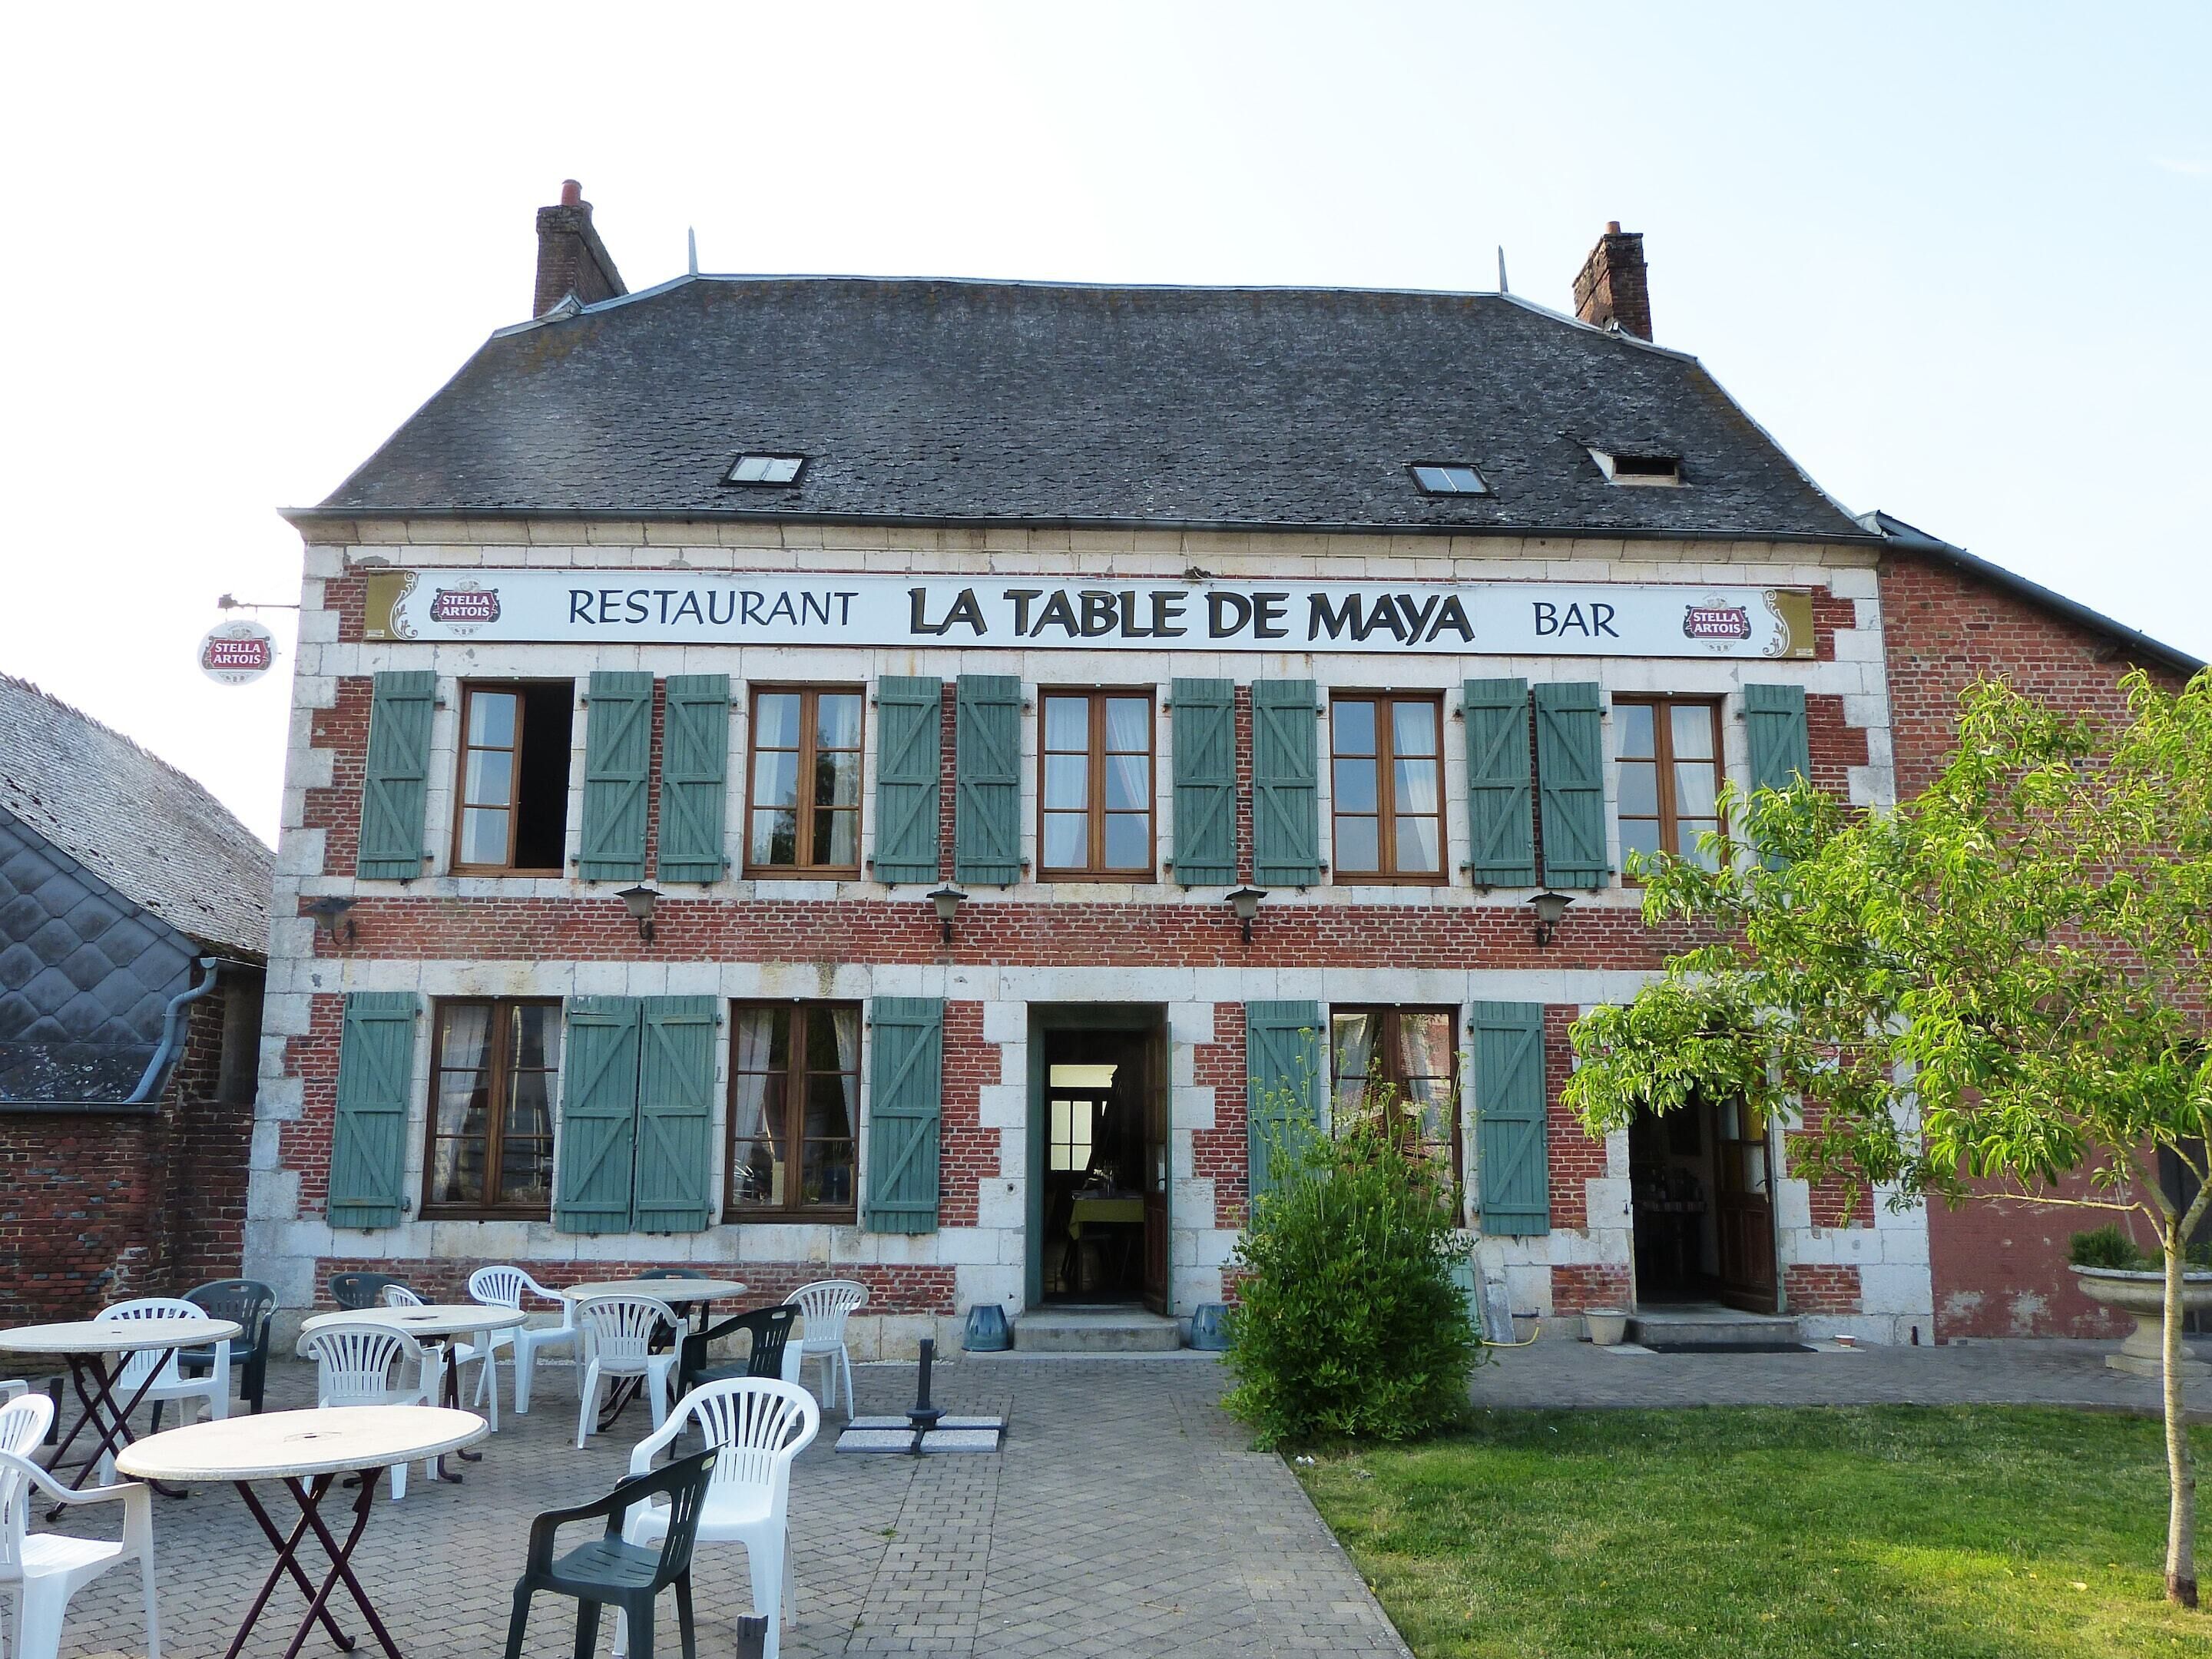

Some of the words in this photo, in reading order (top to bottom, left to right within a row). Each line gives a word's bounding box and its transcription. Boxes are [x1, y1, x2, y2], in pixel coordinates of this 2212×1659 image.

[442, 594, 489, 605] STELLA
[441, 607, 490, 617] ARTOIS
[568, 588, 859, 626] RESTAURANT
[908, 588, 988, 637] LA
[1003, 589, 1188, 638] TABLE
[1204, 591, 1290, 639] DE
[1307, 592, 1475, 646] MAYA
[1532, 601, 1620, 637] BAR
[1693, 612, 1740, 622] STELLA
[1694, 623, 1741, 634] ARTOIS
[215, 643, 261, 653] STELLA
[214, 654, 261, 664] ARTOIS
